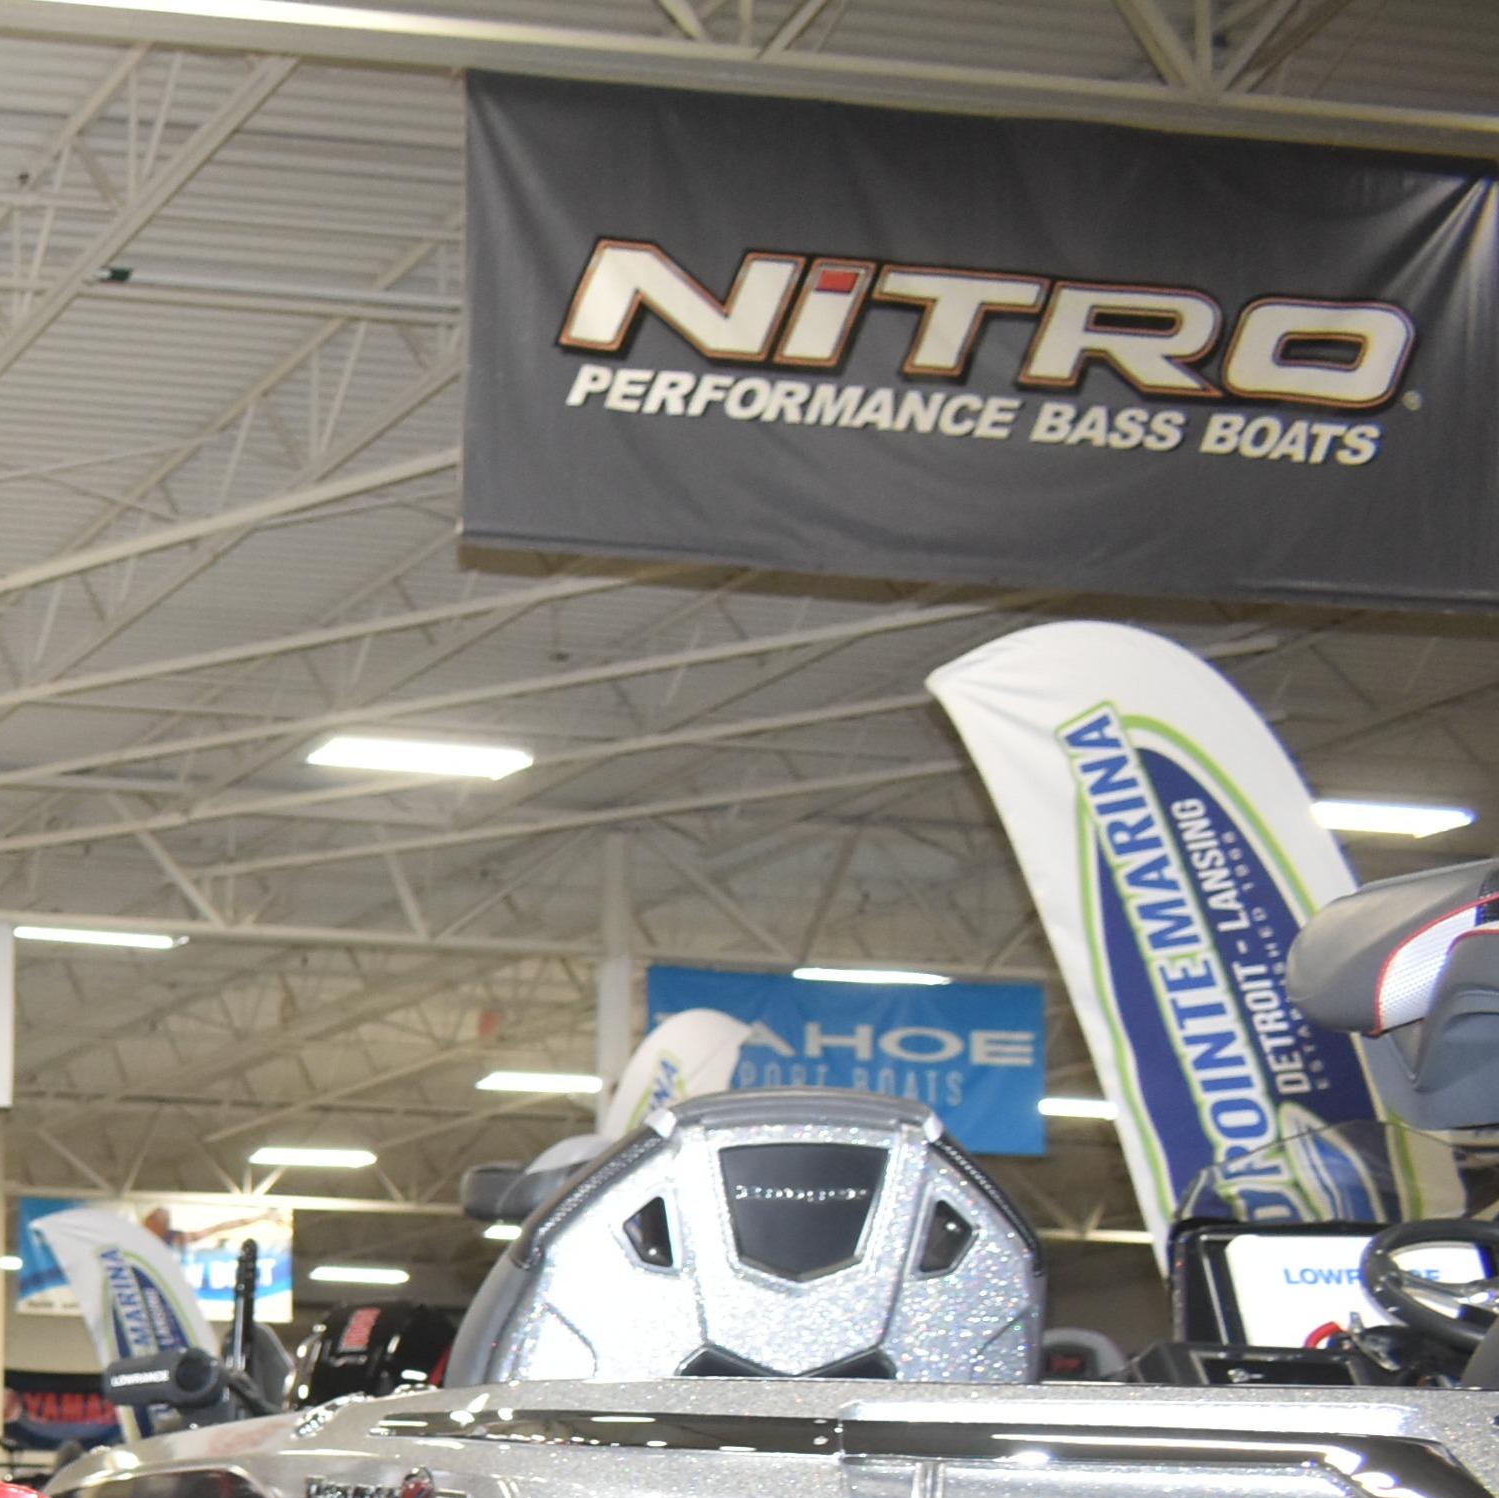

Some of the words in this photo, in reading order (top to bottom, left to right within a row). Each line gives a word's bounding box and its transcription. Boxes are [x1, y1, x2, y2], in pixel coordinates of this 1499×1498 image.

[565, 363, 1016, 441] PERFORMANCE
[1030, 403, 1184, 453] BASS
[1200, 418, 1382, 467] BOATS
[1066, 713, 1206, 950] MARINA
[1171, 798, 1251, 933] LANSING
[655, 1010, 1036, 1067] AHOE
[1233, 961, 1311, 1096] DETROIT
[100, 1248, 153, 1347] MARINA
